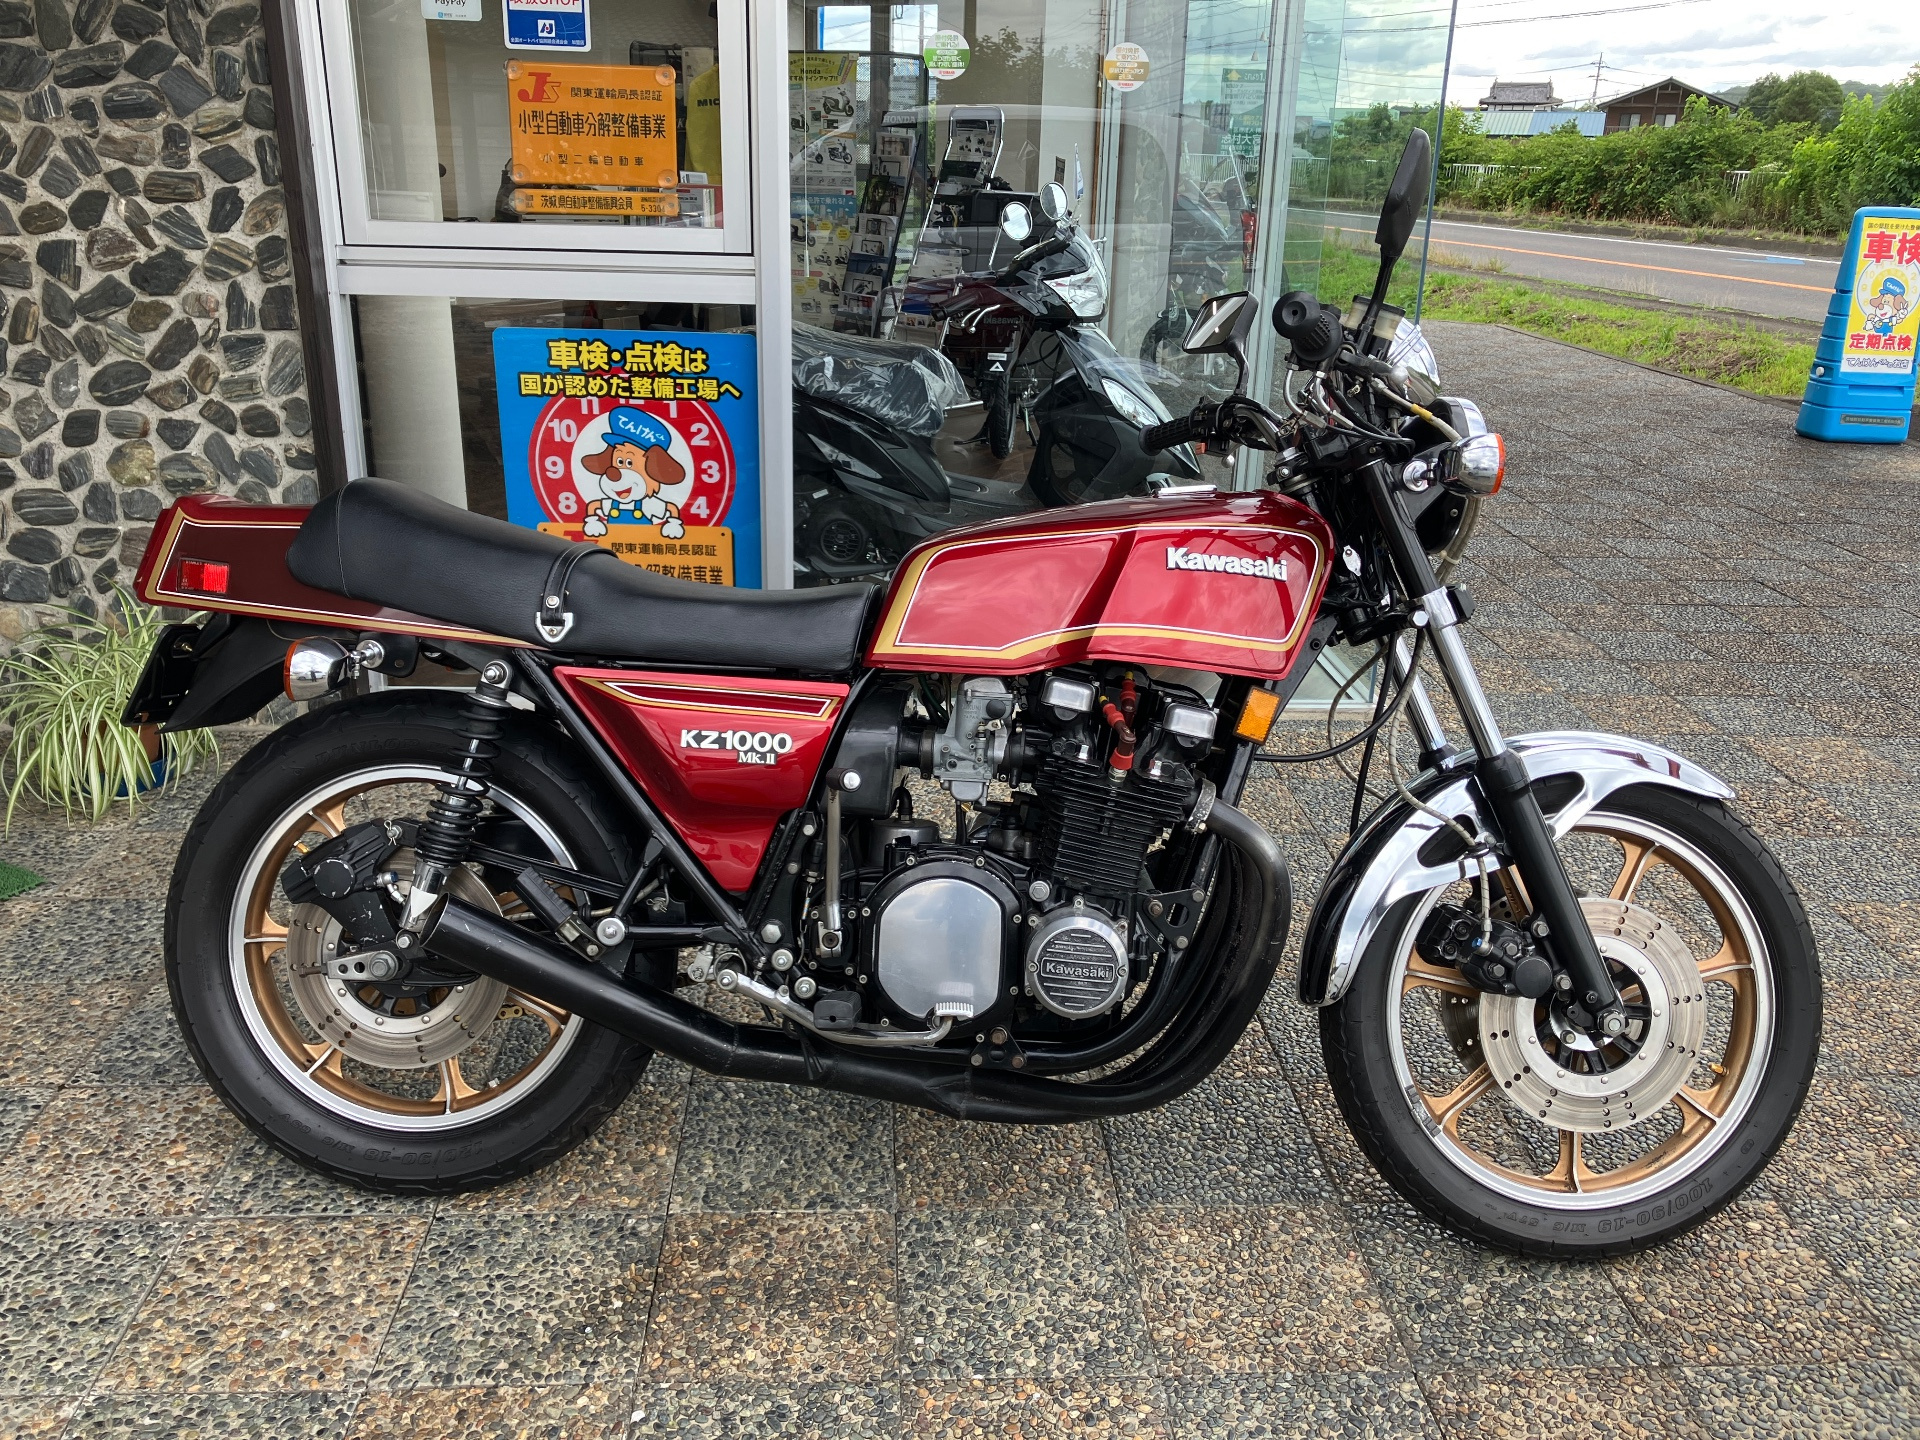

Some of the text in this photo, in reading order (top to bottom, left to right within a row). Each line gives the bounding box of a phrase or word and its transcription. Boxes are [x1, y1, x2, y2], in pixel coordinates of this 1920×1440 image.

[570, 86, 663, 102] 関東運輸局長認証
[518, 110, 667, 140] 小型自動車分解整備事業
[883, 115, 916, 124] HONDA
[1863, 231, 1920, 265] 車検
[1848, 333, 1912, 350] 定期点検
[549, 340, 707, 373] 車検・点検は
[520, 374, 742, 400] 国が認めた整備工場へ
[550, 419, 577, 442] 10
[690, 424, 709, 446] 2
[544, 456, 564, 478] 9
[701, 462, 720, 484] 3
[558, 492, 577, 514] 8
[690, 497, 709, 518] 4
[611, 542, 717, 556] 関東運輸局長認証
[1166, 546, 1288, 582] Kawasaki
[680, 729, 792, 753] KZ1000
[1046, 963, 1109, 978] Kawasaki
[362, 1140, 484, 1166] 120/90-18
[1597, 1177, 1714, 1233] 100/90-19
[1552, 1222, 1586, 1233] M/C
